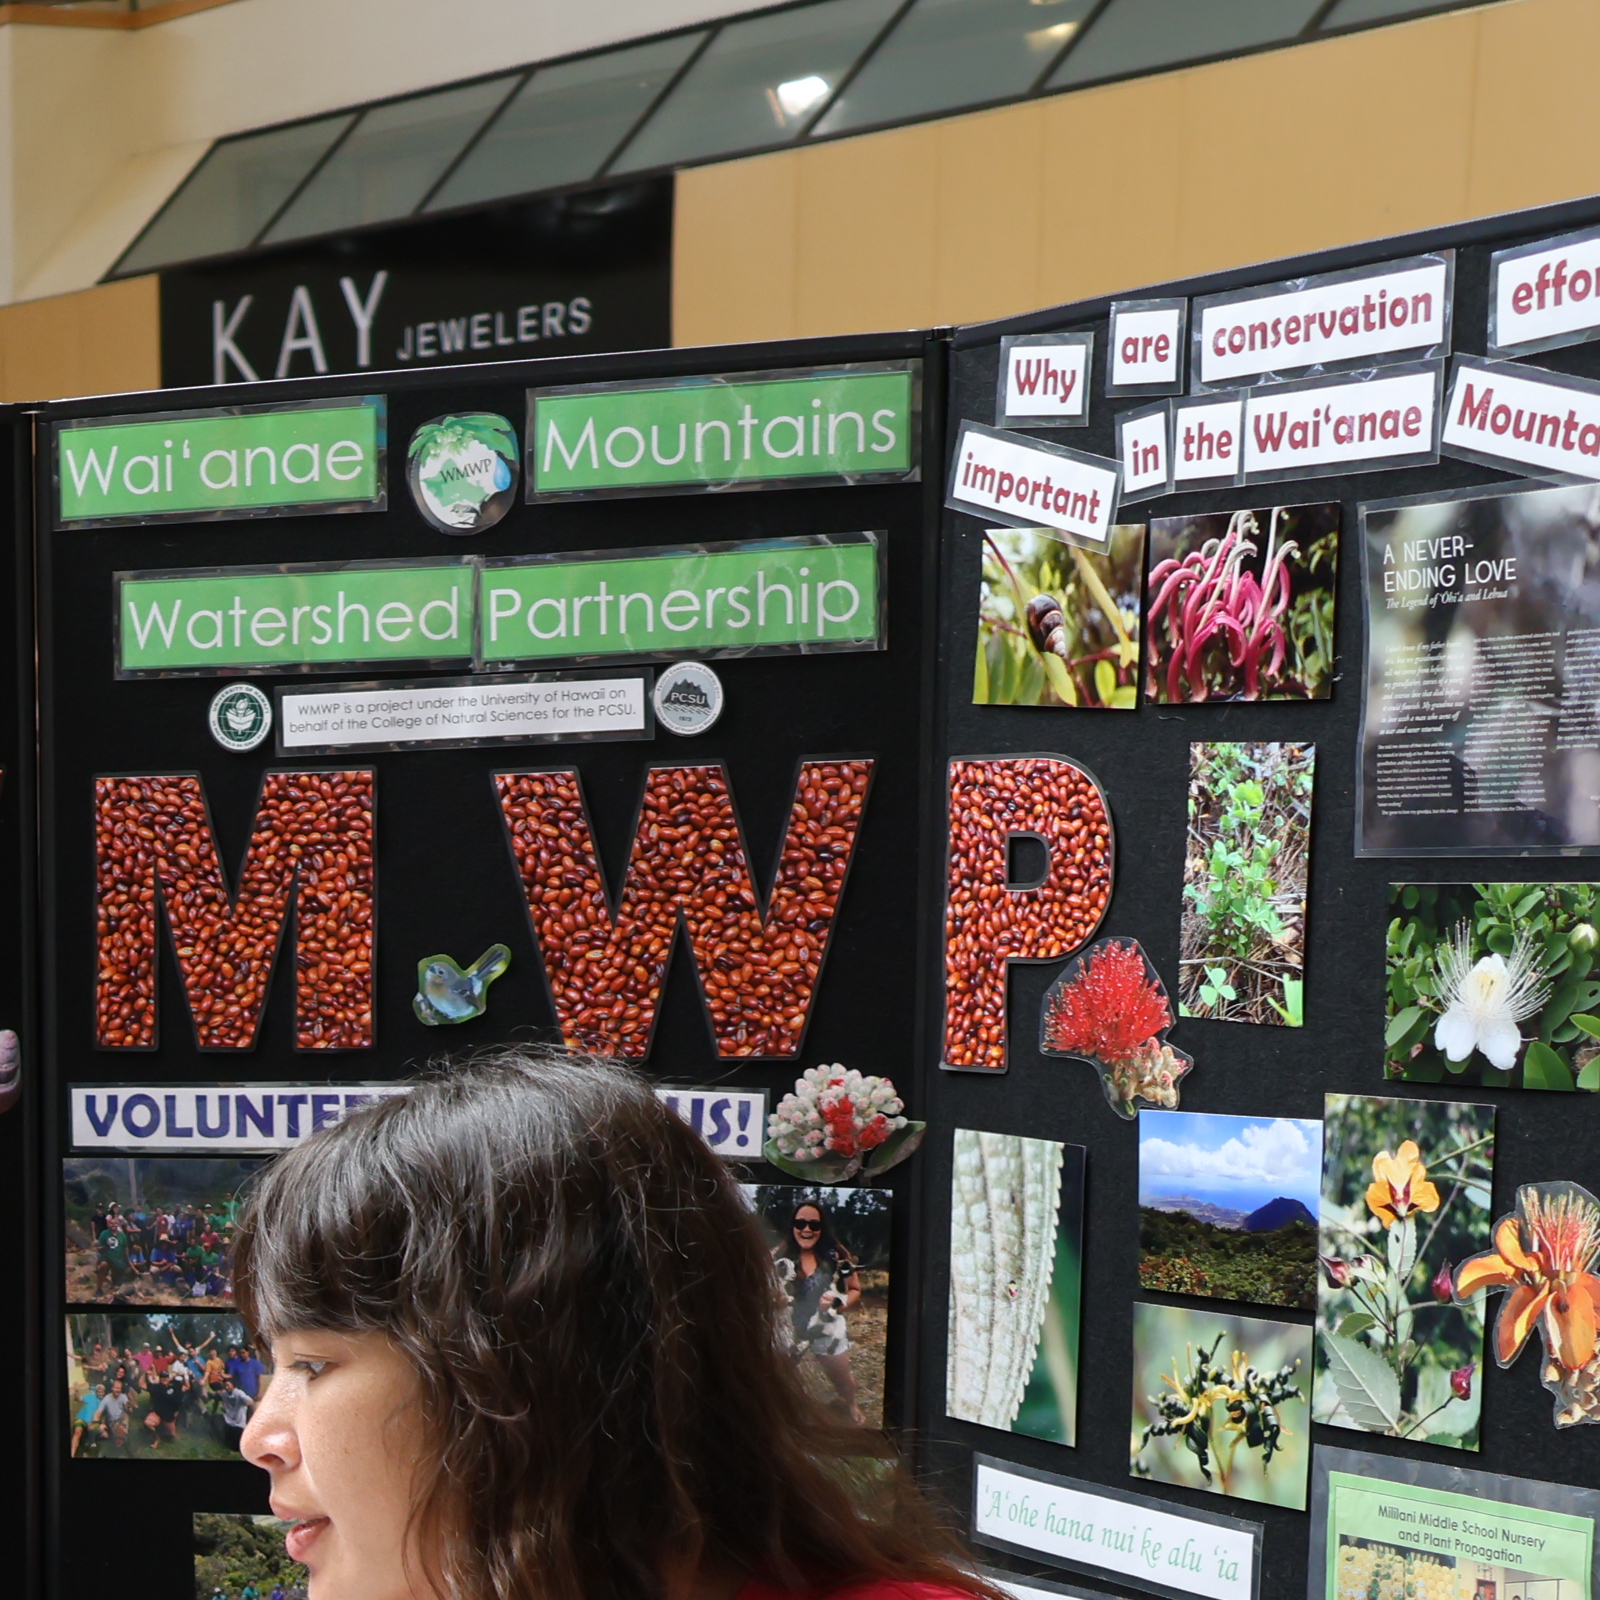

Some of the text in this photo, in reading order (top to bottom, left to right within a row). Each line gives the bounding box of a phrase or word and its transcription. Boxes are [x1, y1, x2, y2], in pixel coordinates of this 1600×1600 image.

[212, 271, 592, 384] KAY JEWELERS
[1015, 358, 1076, 403] Why
[1121, 330, 1170, 364] are
[1212, 289, 1432, 357] conservation
[543, 398, 897, 472] Mountains
[440, 458, 491, 483] WMWP
[962, 453, 1100, 525] important
[1132, 437, 1158, 476] in
[1183, 422, 1232, 461] the
[1383, 535, 1474, 565] A NEVER-
[1384, 557, 1517, 593] ENDING LOVE
[129, 569, 860, 650] Watershed Partnership
[1386, 596, 1399, 609] The
[1401, 593, 1428, 609] Legend
[1483, 587, 1508, 600] Lehua
[290, 703, 636, 733] behalf of the College of Natural Sciences for the PCSU.
[298, 689, 626, 717] WMWP is a project under the University of Hawaii on
[671, 692, 706, 704] PCSU
[85, 1093, 400, 1138] VOLUNTE
[1044, 1503, 1094, 1543] hana
[1101, 1525, 1136, 1554] nui
[1141, 1527, 1162, 1569] ke
[1168, 1538, 1203, 1573] alu
[1378, 1505, 1546, 1551] Mililani Middle School Nursery
[1398, 1530, 1523, 1564] and Plant Propagation
